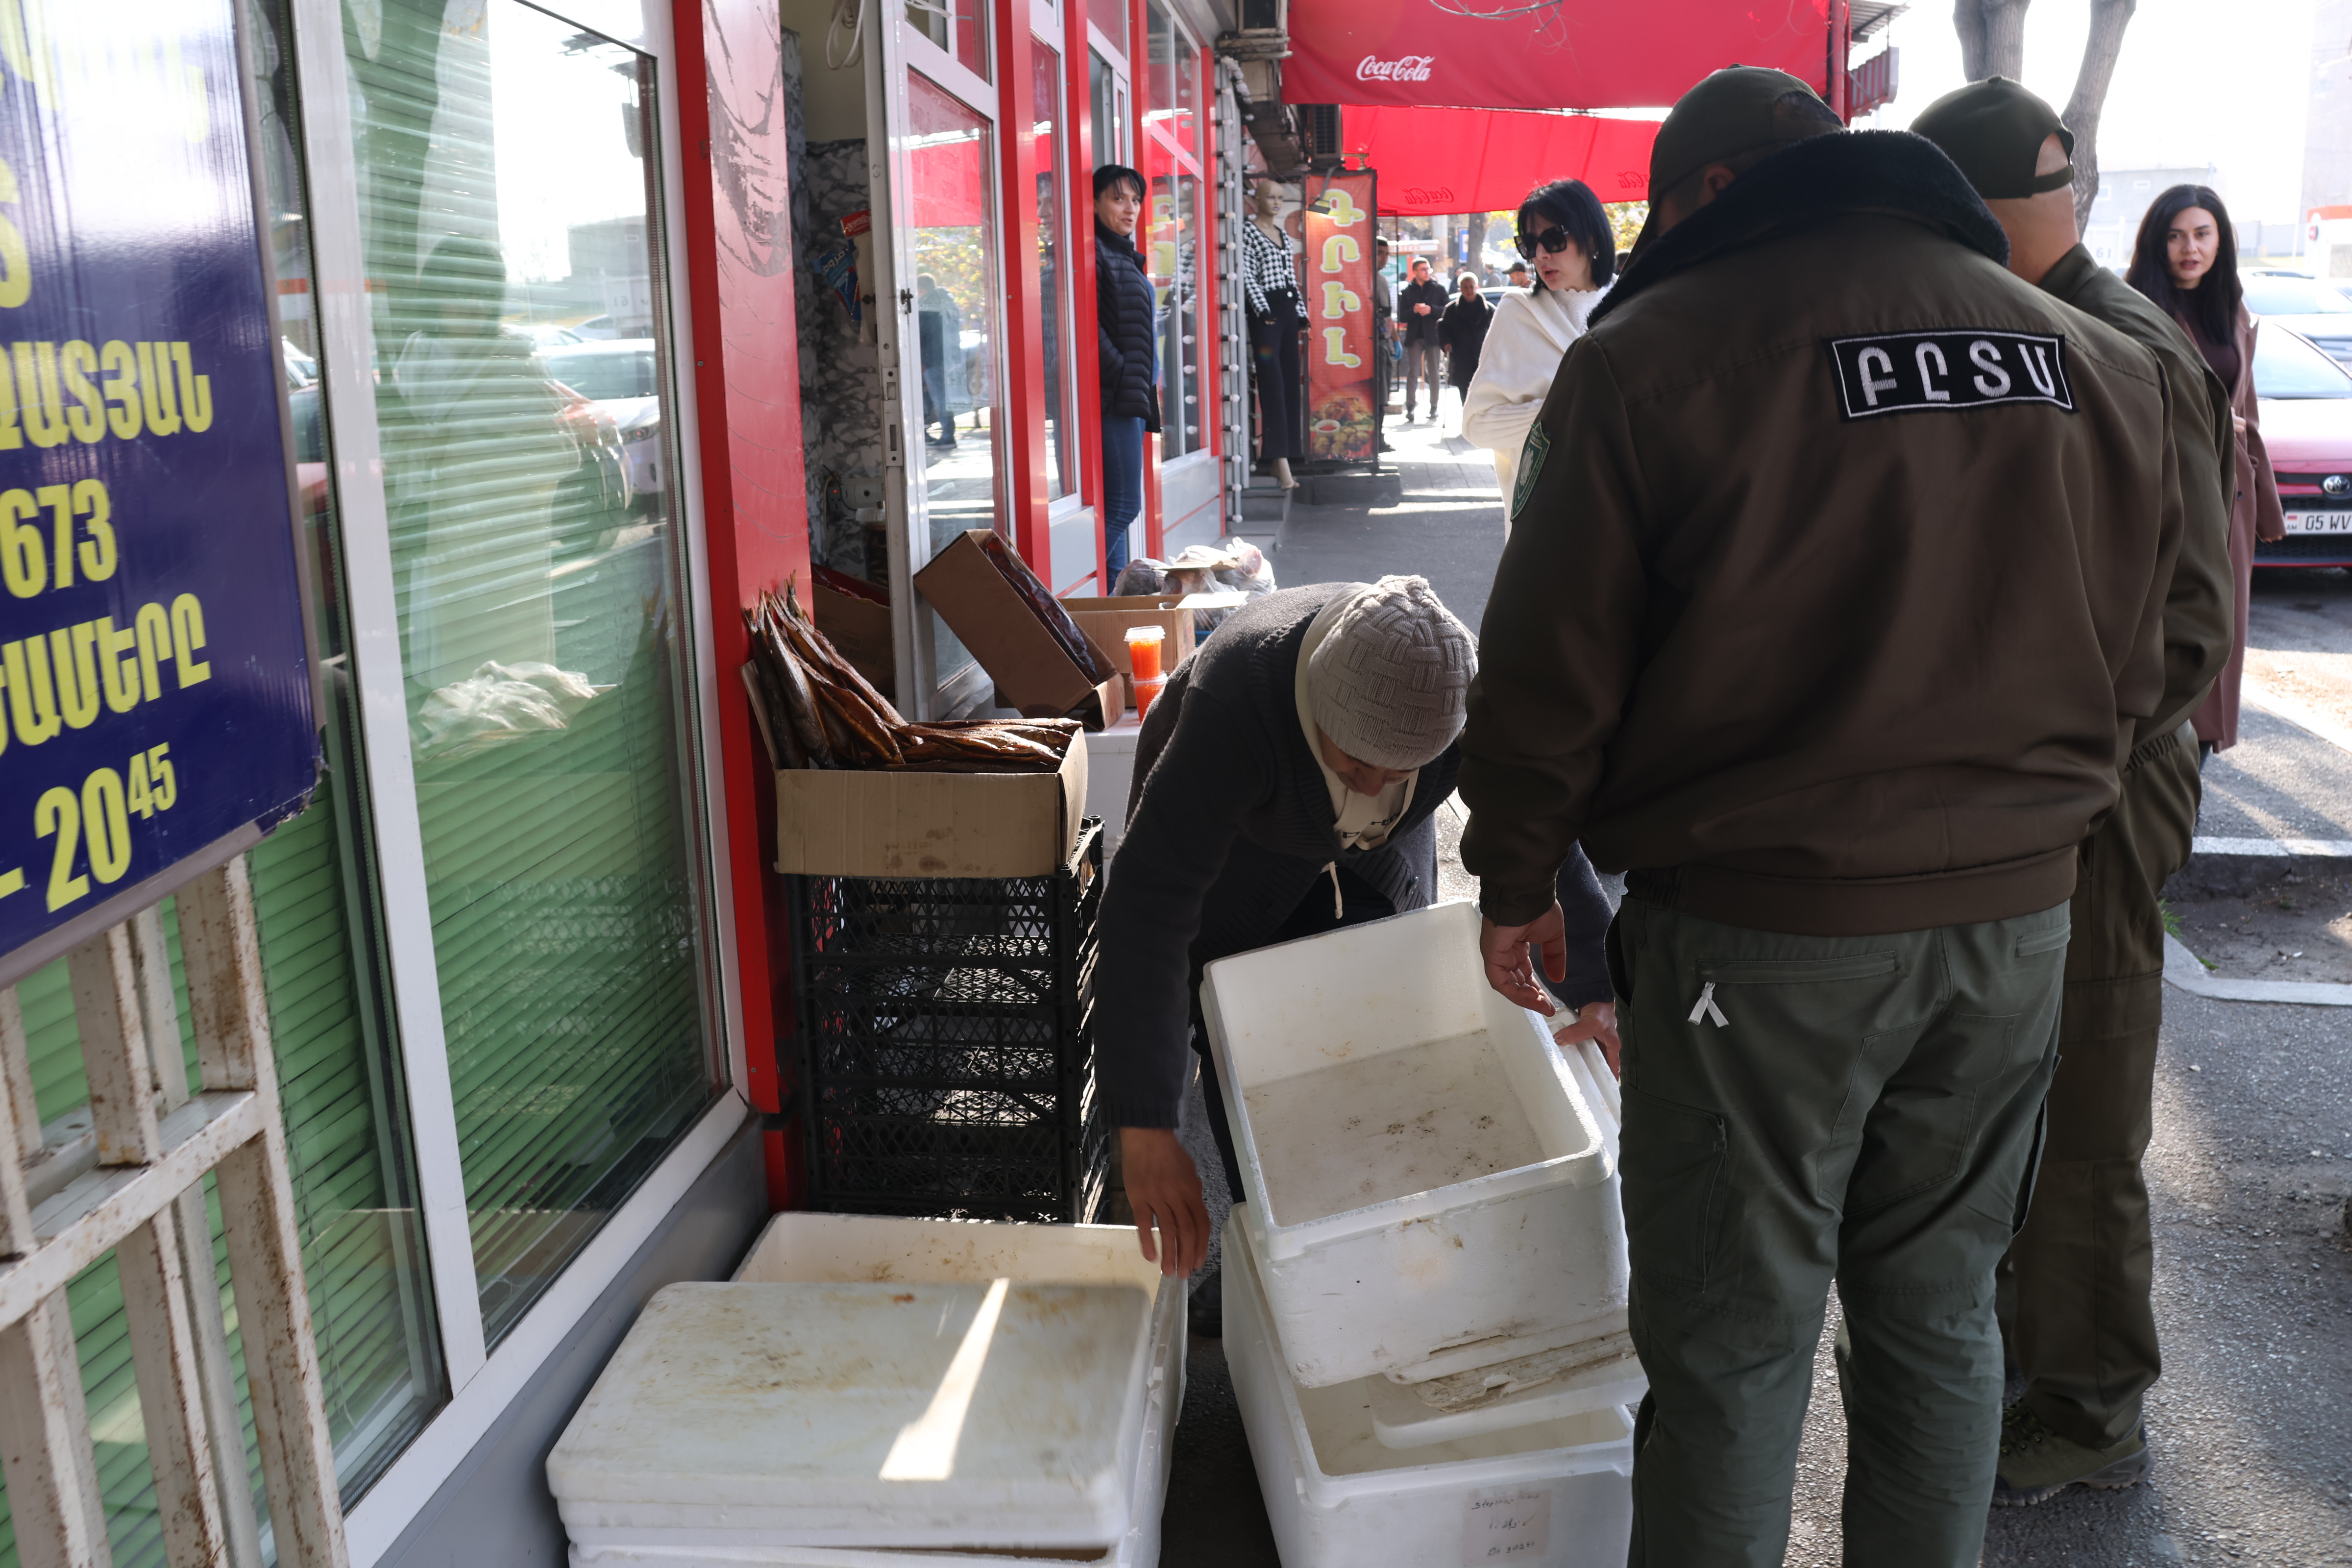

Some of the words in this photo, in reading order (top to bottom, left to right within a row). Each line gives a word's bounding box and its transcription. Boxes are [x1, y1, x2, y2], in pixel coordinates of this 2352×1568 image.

[1356, 55, 1436, 81] Coca-Cola
[1858, 340, 2056, 406] ԲԸՏՄ
[0, 478, 118, 598] 673
[2305, 515, 2324, 530] 05
[0, 593, 212, 757] ԱՄԵՐԸ
